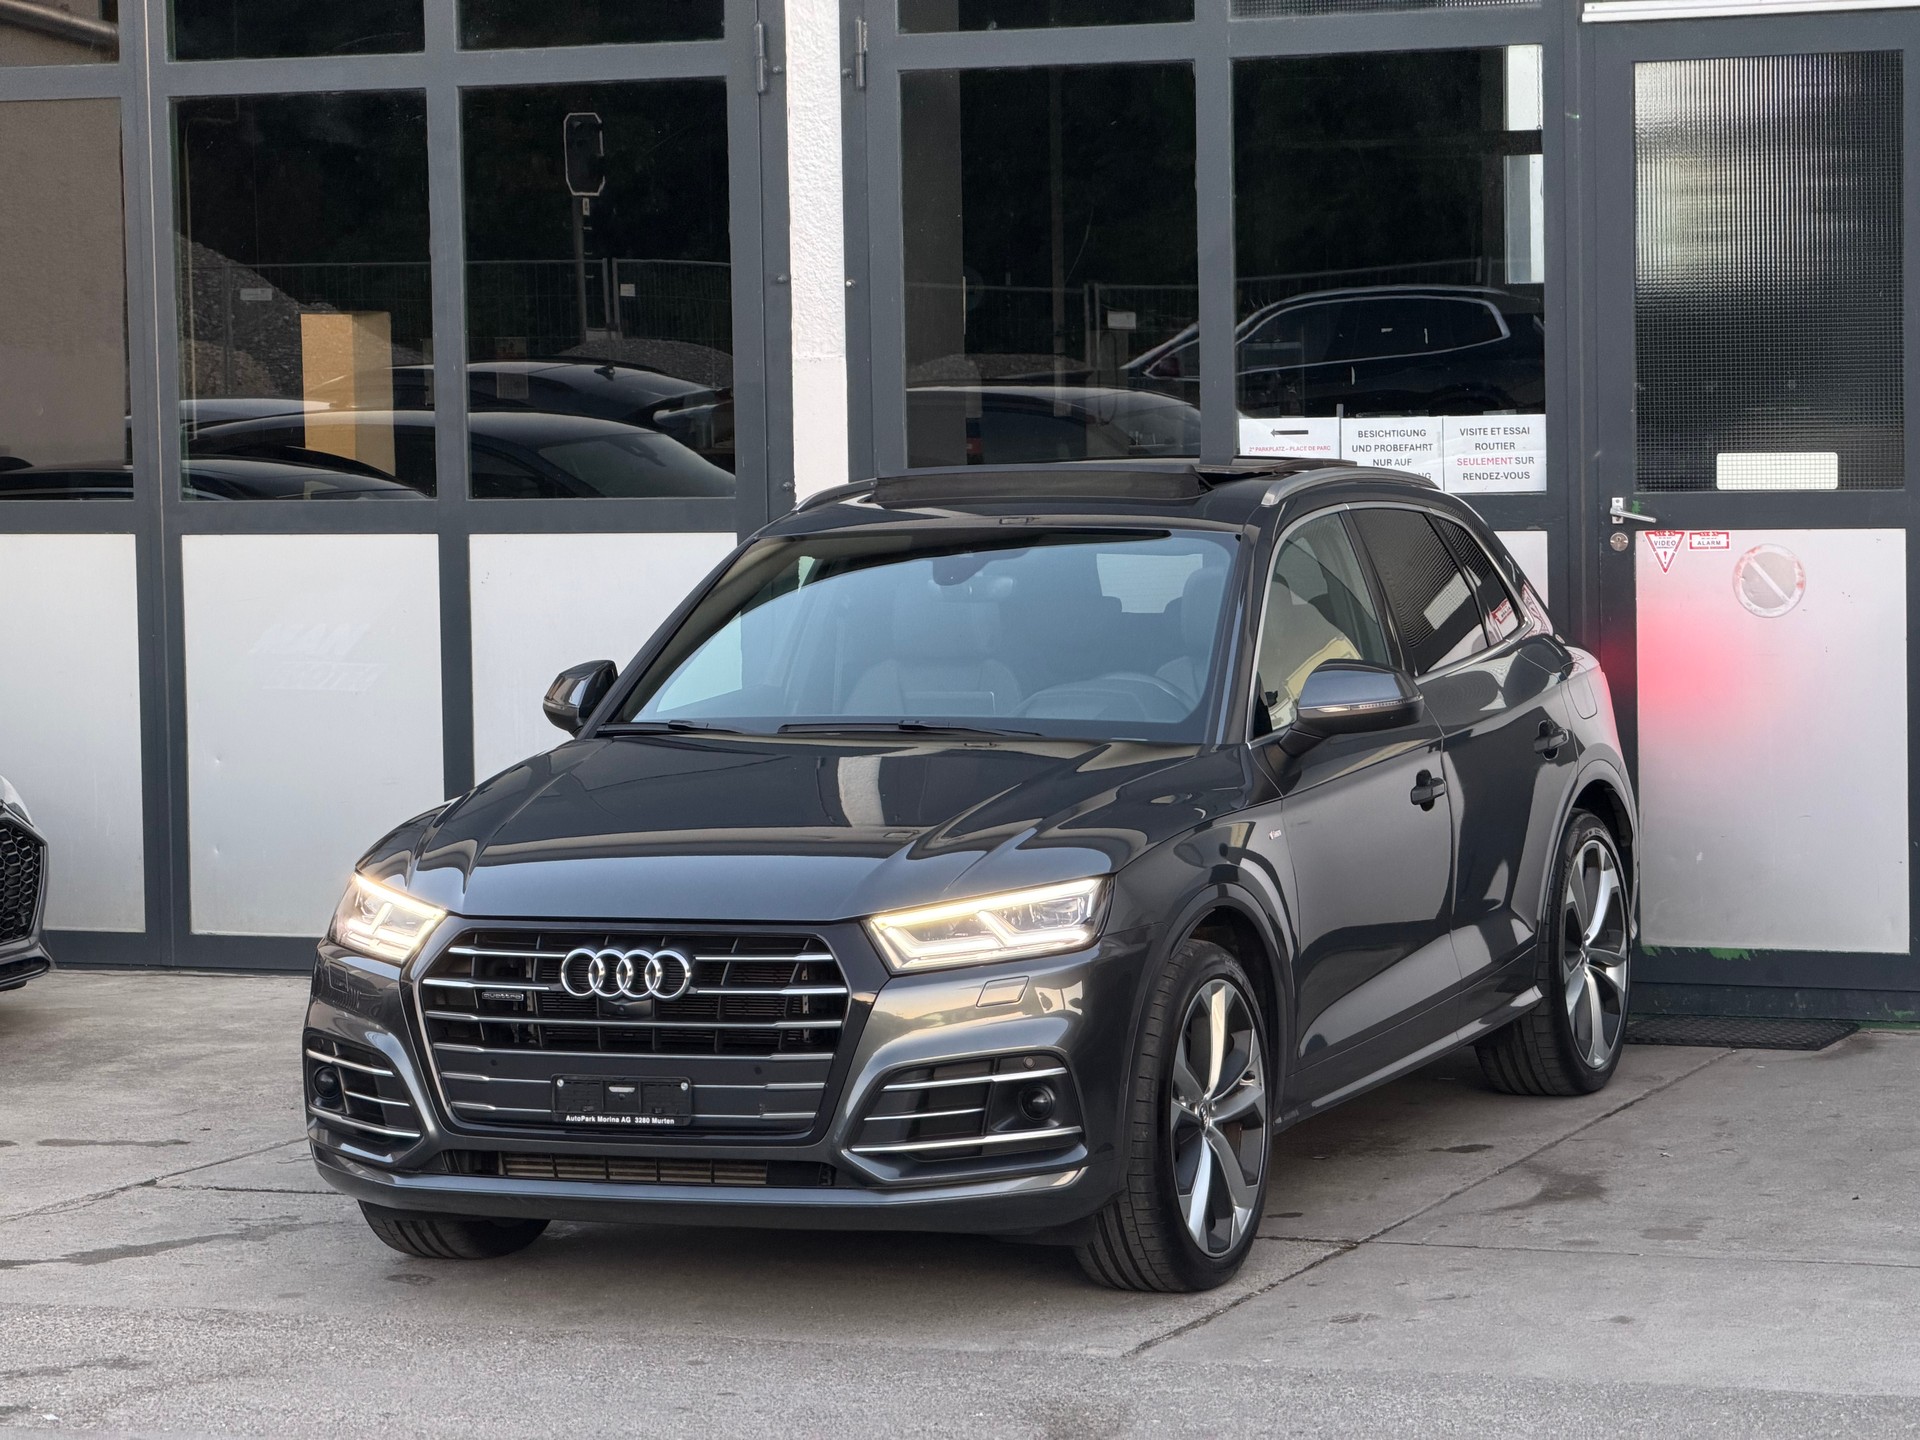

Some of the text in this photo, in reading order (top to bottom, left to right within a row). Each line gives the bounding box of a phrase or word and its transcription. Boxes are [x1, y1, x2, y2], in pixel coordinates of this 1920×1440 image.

[1357, 429, 1427, 438] BESICHTIGUNG
[1459, 426, 1530, 436] VISITE ET ESSAI
[1351, 443, 1433, 453] UND PROBEFAHRT
[1474, 442, 1516, 451] ROUTIER
[1372, 458, 1412, 467] NUR AUF
[1456, 456, 1535, 466] SEULEMENT SUR
[1462, 471, 1531, 481] RENDEZ-VOUS
[634, 1116, 651, 1124] 3280
[651, 1117, 675, 1125] Murten
